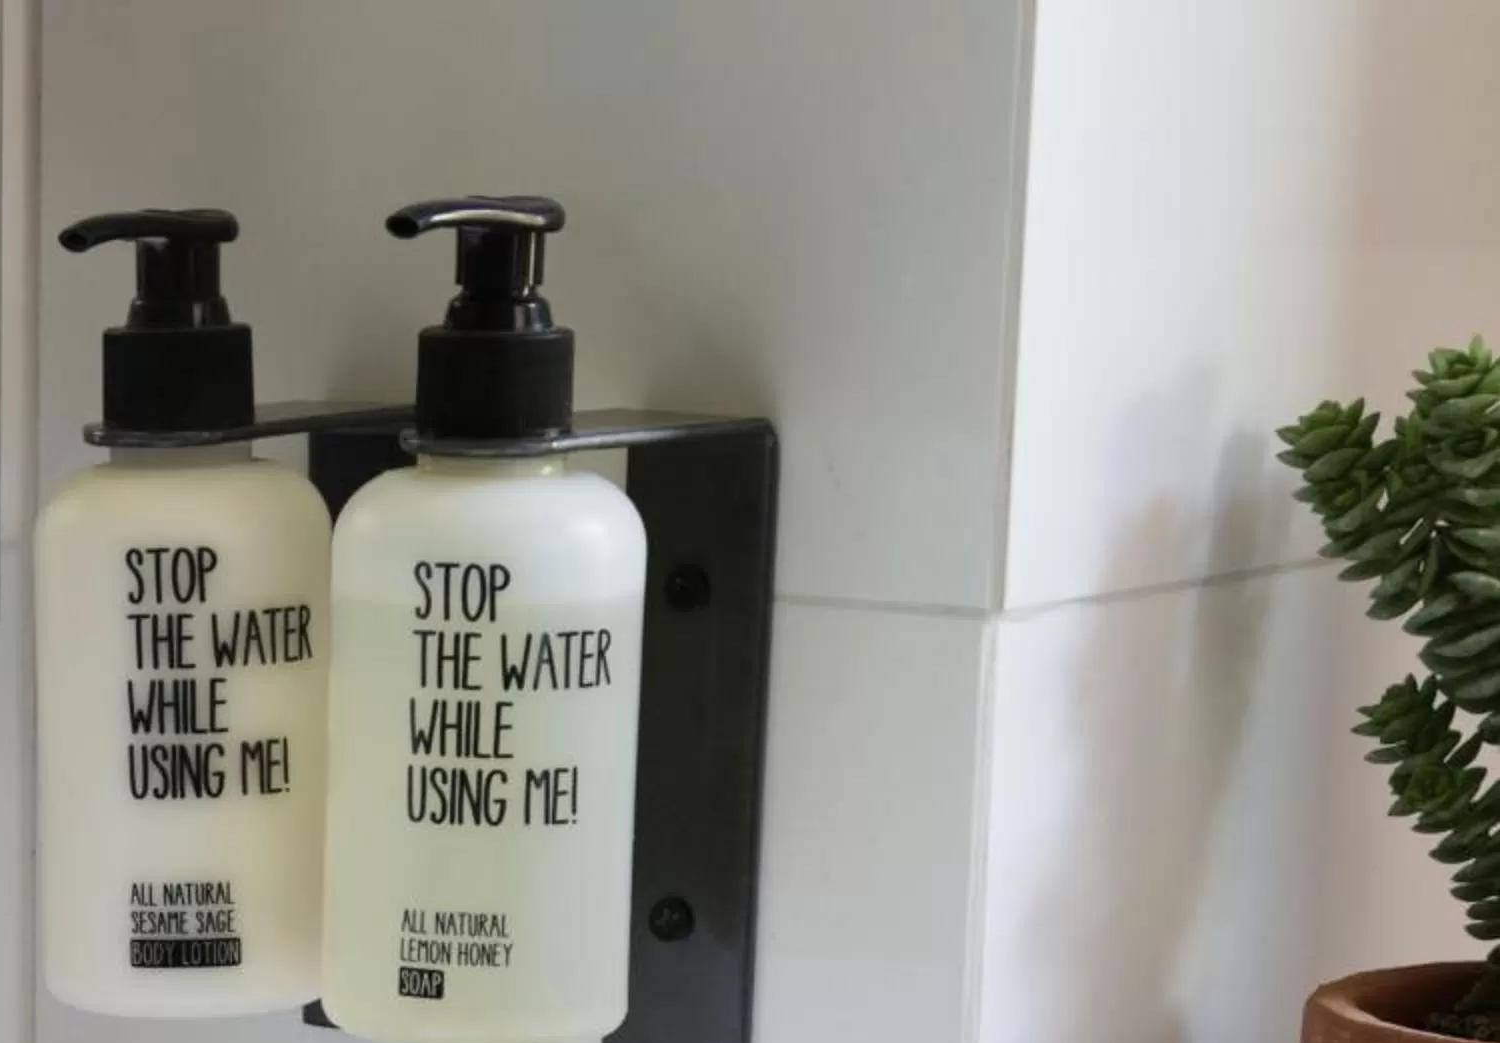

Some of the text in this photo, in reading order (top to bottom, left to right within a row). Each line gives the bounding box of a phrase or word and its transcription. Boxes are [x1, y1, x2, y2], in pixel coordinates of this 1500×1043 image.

[125, 547, 218, 604] STOP
[413, 561, 511, 622] STOP
[126, 604, 313, 670] THE WATER
[412, 629, 612, 691] THE WATER
[127, 677, 229, 735] WHILE
[409, 697, 514, 759] WHILE
[127, 736, 290, 800] USING ME!
[407, 764, 578, 827] USING ME!
[131, 880, 235, 906] ALL NATURAL
[131, 909, 236, 935] SESAME SAGE
[401, 908, 509, 937] ALL NATURAL
[131, 939, 240, 966] BODY LOTION
[400, 936, 513, 968] LEMON HONEY
[400, 969, 443, 998] SOAP
